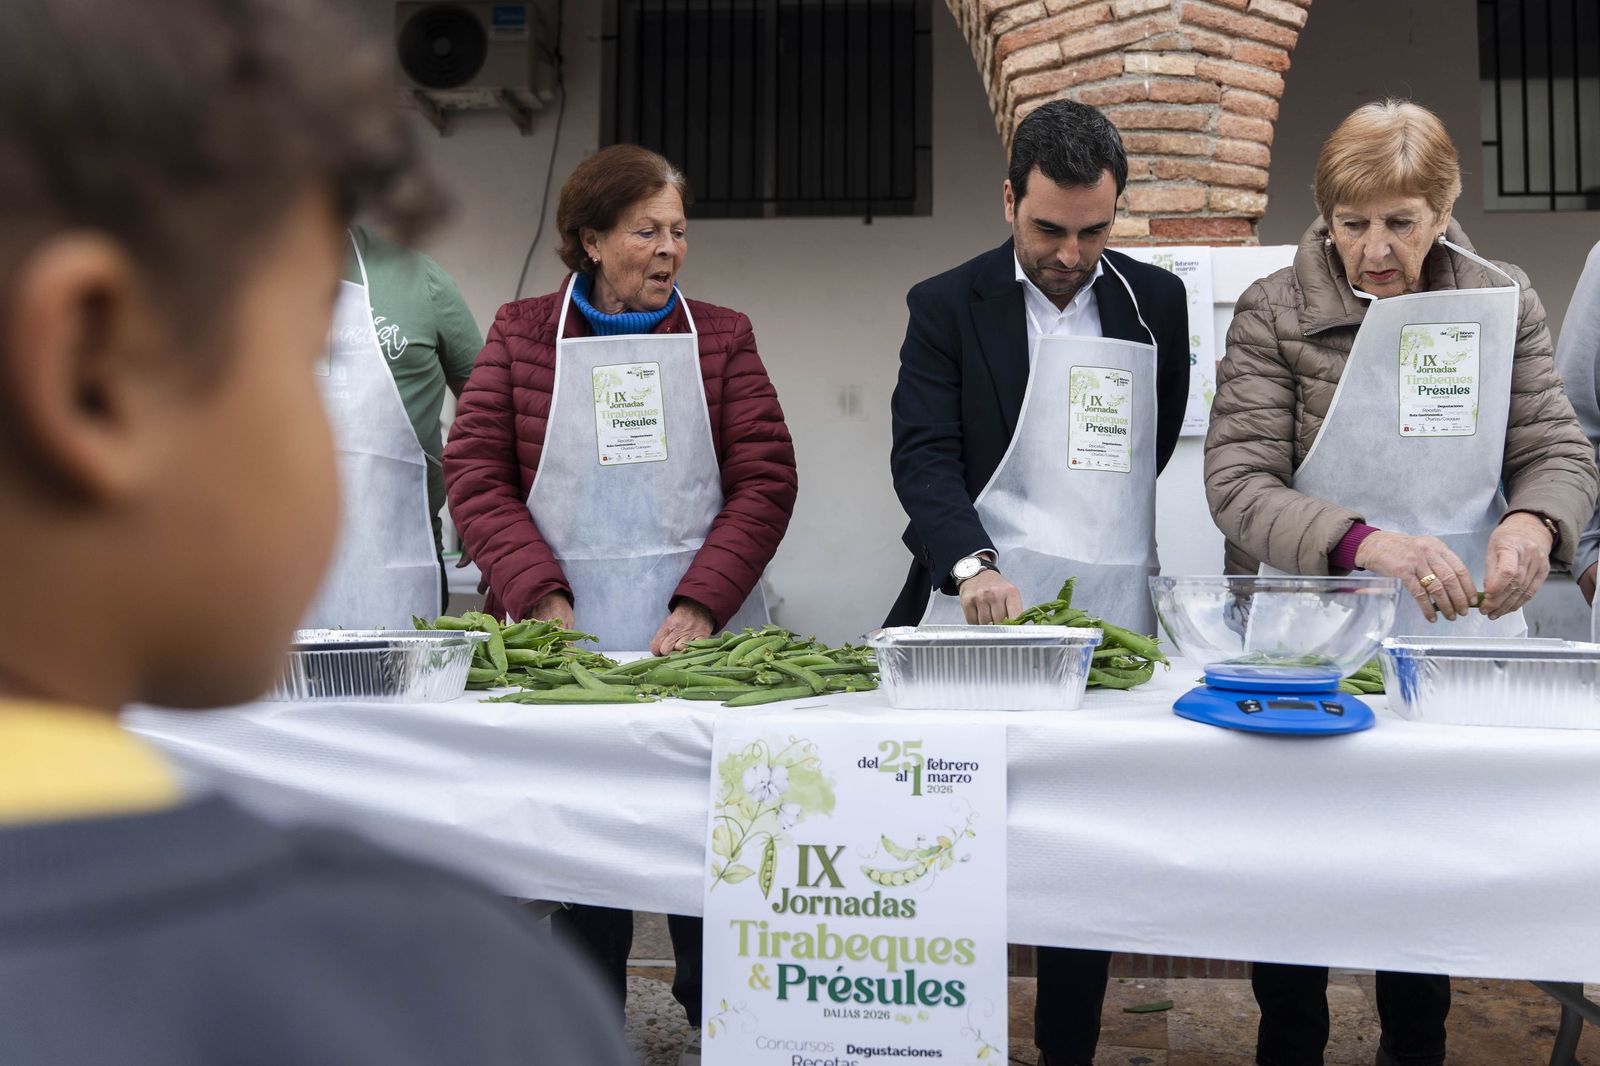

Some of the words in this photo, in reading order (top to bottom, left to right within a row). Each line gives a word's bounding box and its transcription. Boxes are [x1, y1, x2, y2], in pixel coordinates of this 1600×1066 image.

[1423, 354, 1438, 366] IX
[1416, 365, 1457, 374] Jornadas
[1406, 374, 1473, 387] Tirabeques
[614, 391, 627, 402] IX
[1418, 385, 1470, 396] Présules
[609, 401, 645, 409] Jornadas
[1090, 395, 1103, 407] IX
[600, 408, 658, 420] Tirabeques
[1084, 405, 1118, 414] Jornadas
[612, 417, 657, 428] Présules
[1075, 412, 1128, 426] Tirabeques
[1085, 422, 1127, 435] Présules
[857, 757, 879, 769] del
[878, 740, 924, 773] 25
[927, 758, 979, 771] febrero
[896, 770, 908, 782] al
[911, 764, 923, 796] 1
[927, 773, 972, 784] marzo
[927, 785, 953, 794] 2026
[796, 844, 847, 889] IX
[772, 888, 916, 918] Jornadas
[730, 919, 976, 973] Tirabeques
[748, 963, 771, 990] &
[776, 964, 966, 1007] Présules
[863, 1009, 890, 1020] 2026
[755, 1036, 835, 1053] Concursos
[846, 1044, 943, 1059] Degustaciones
